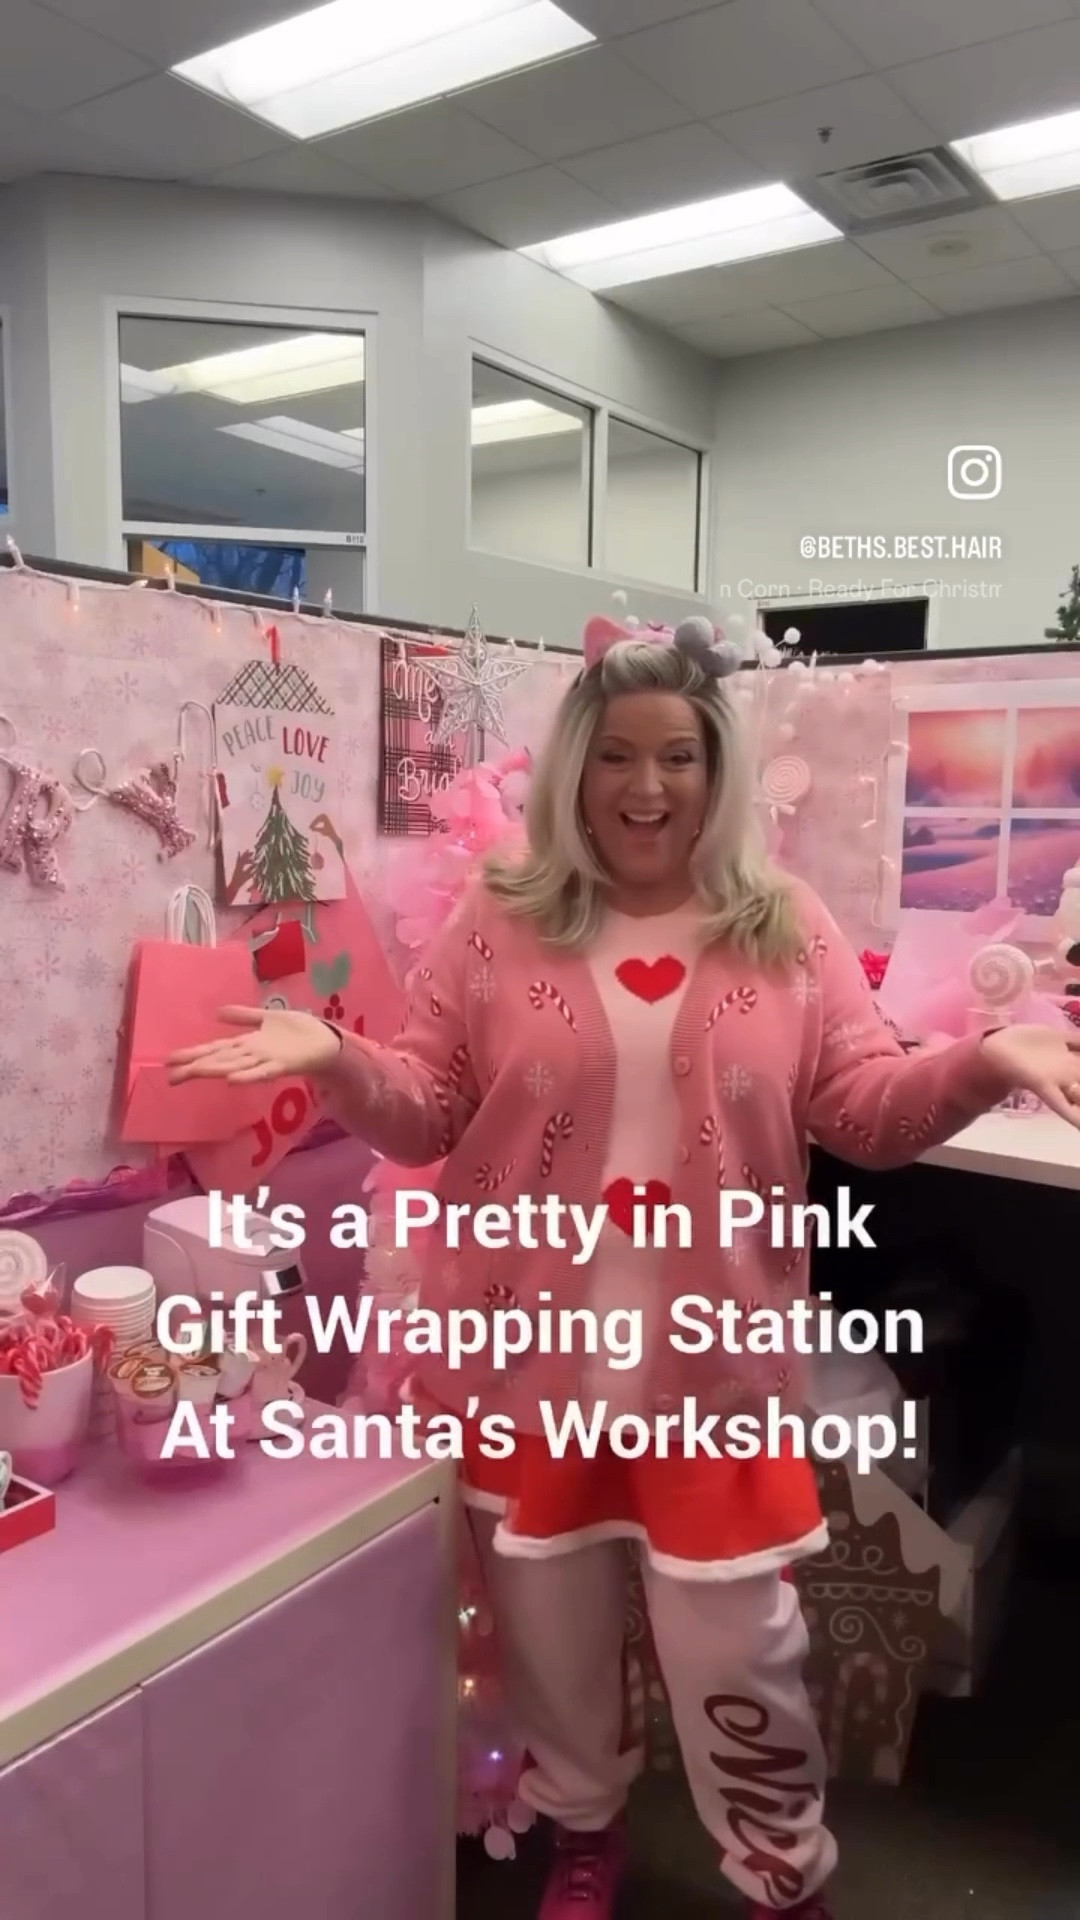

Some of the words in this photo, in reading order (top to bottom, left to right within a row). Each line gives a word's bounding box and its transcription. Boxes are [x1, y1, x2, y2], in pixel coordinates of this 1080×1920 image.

[222, 715, 276, 757] PEACE
[282, 726, 330, 764] LOVE
[291, 770, 325, 803] JOY
[251, 1078, 318, 1168] JO
[703, 1694, 820, 1907] Nice
